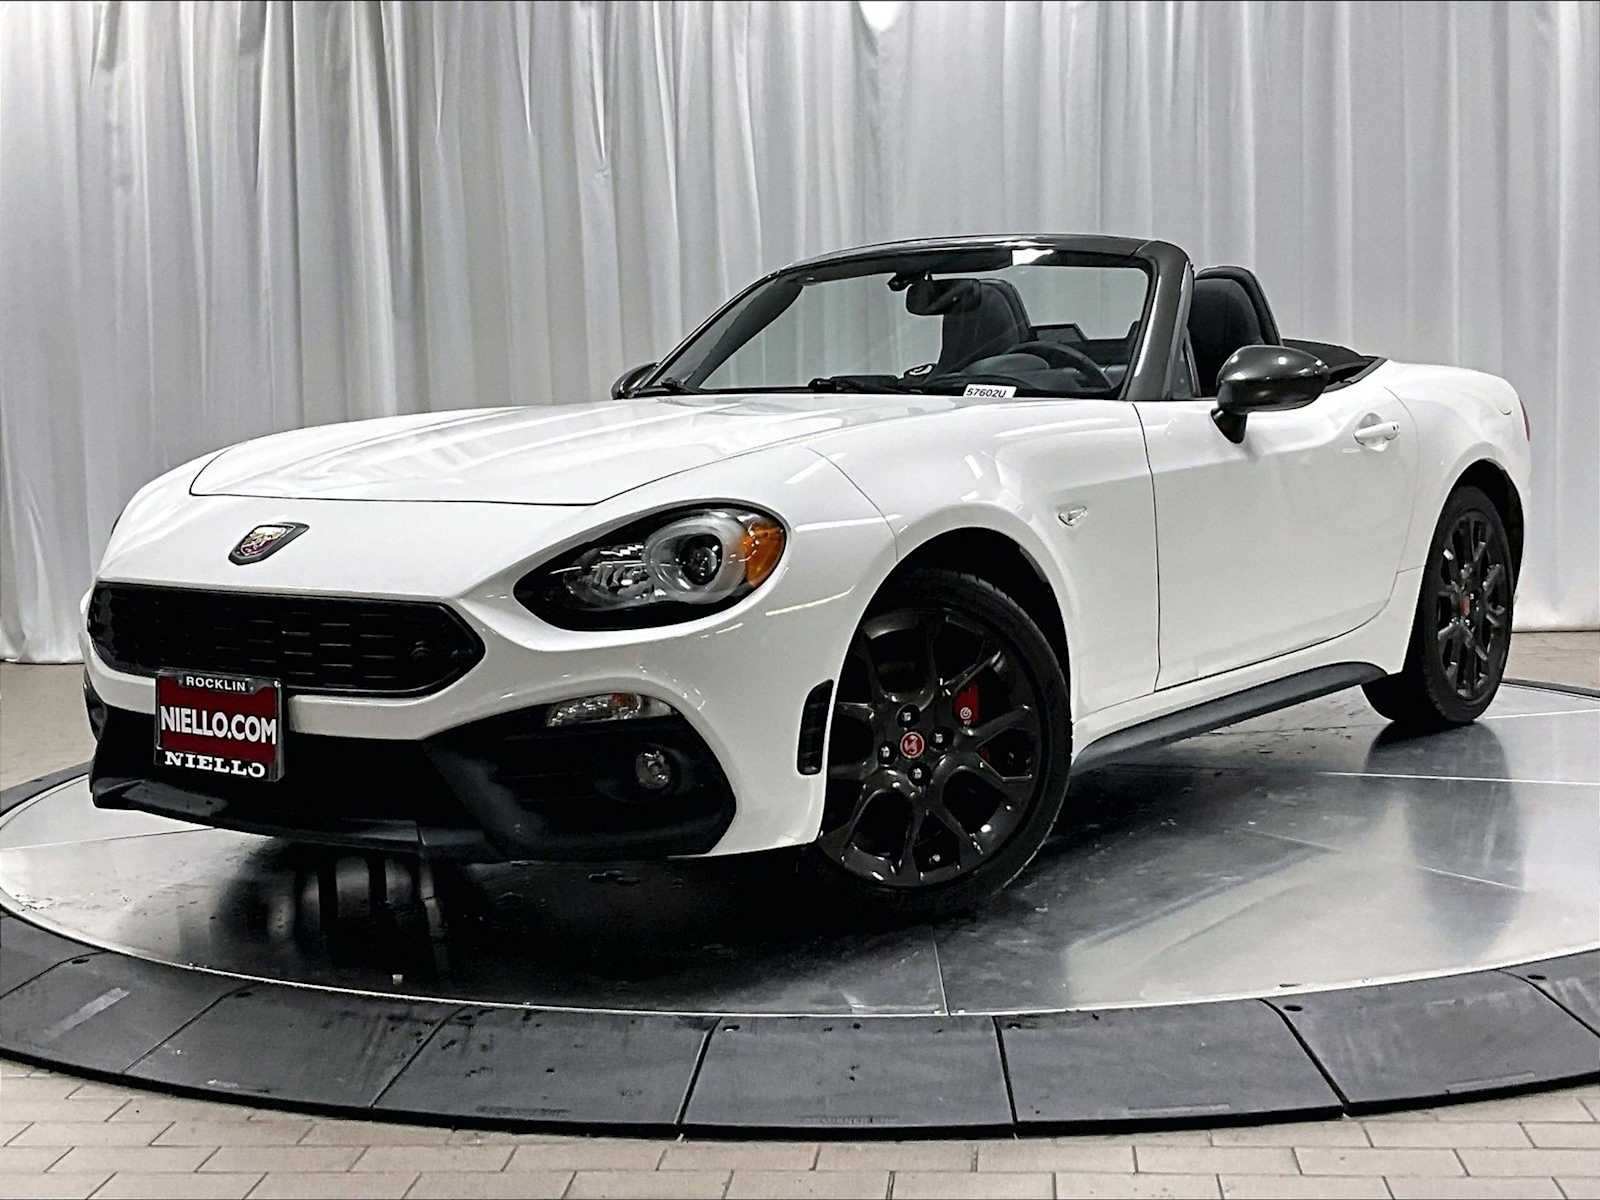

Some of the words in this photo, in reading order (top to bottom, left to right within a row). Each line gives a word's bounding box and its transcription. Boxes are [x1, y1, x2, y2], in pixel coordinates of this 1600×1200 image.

[966, 388, 1007, 398] 57602U
[186, 676, 246, 692] ROCKLIN
[160, 705, 277, 745] NIELLO.COM
[164, 751, 266, 778] NIELLO
